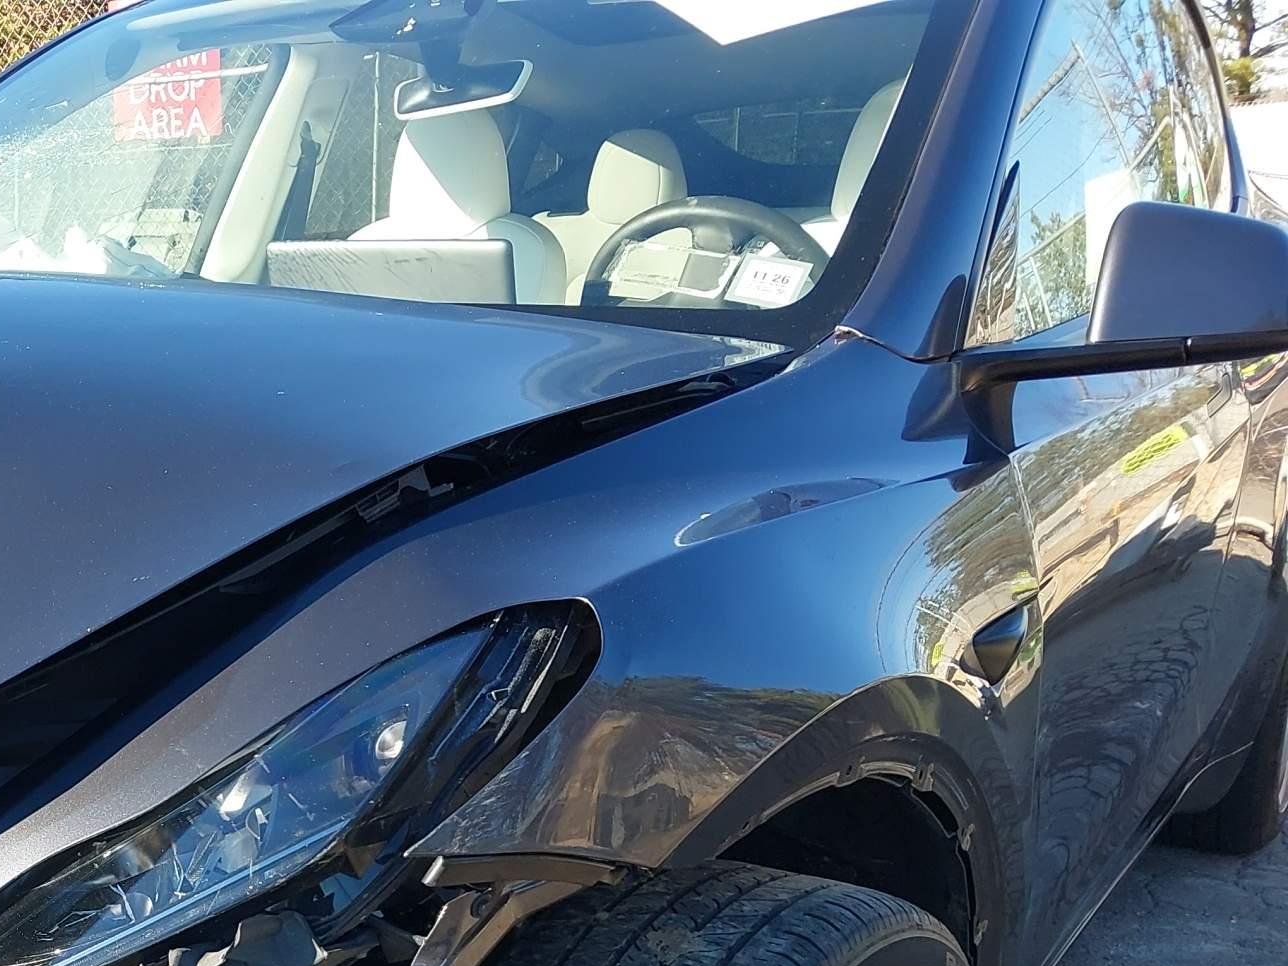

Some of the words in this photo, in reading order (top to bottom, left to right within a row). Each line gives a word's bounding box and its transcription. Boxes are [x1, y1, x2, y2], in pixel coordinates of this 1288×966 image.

[129, 71, 206, 104] DROP
[130, 106, 210, 139] AREA
[772, 273, 791, 285] 26
